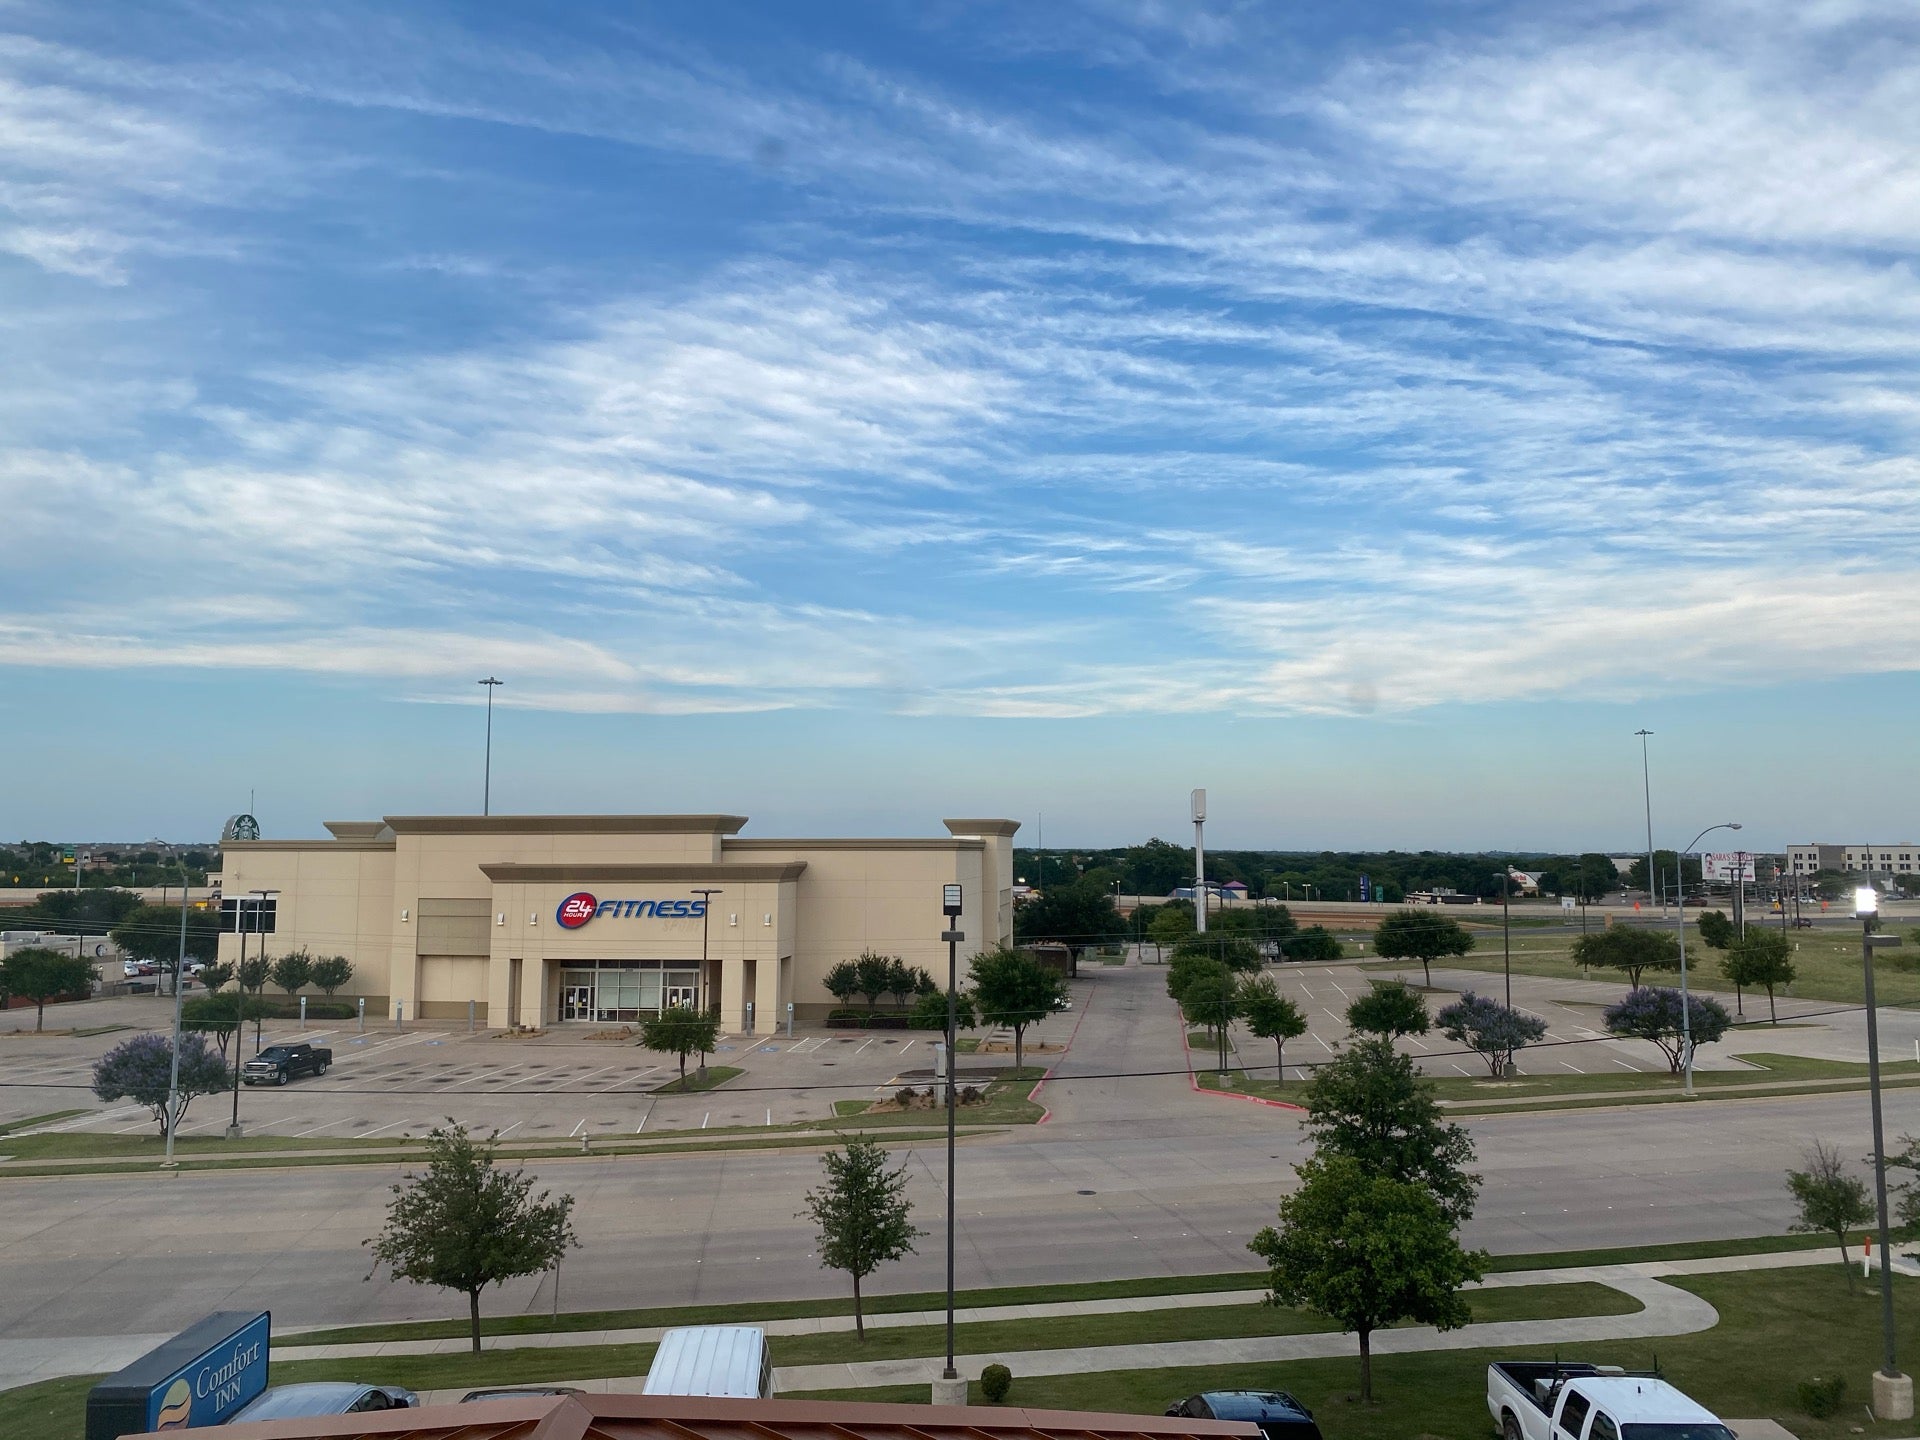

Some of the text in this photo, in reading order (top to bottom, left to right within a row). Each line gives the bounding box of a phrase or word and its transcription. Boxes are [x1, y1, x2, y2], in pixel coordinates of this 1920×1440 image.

[565, 900, 708, 919] 24 FITNESS
[196, 1340, 260, 1399] Comfort
[215, 1377, 241, 1413] INN
